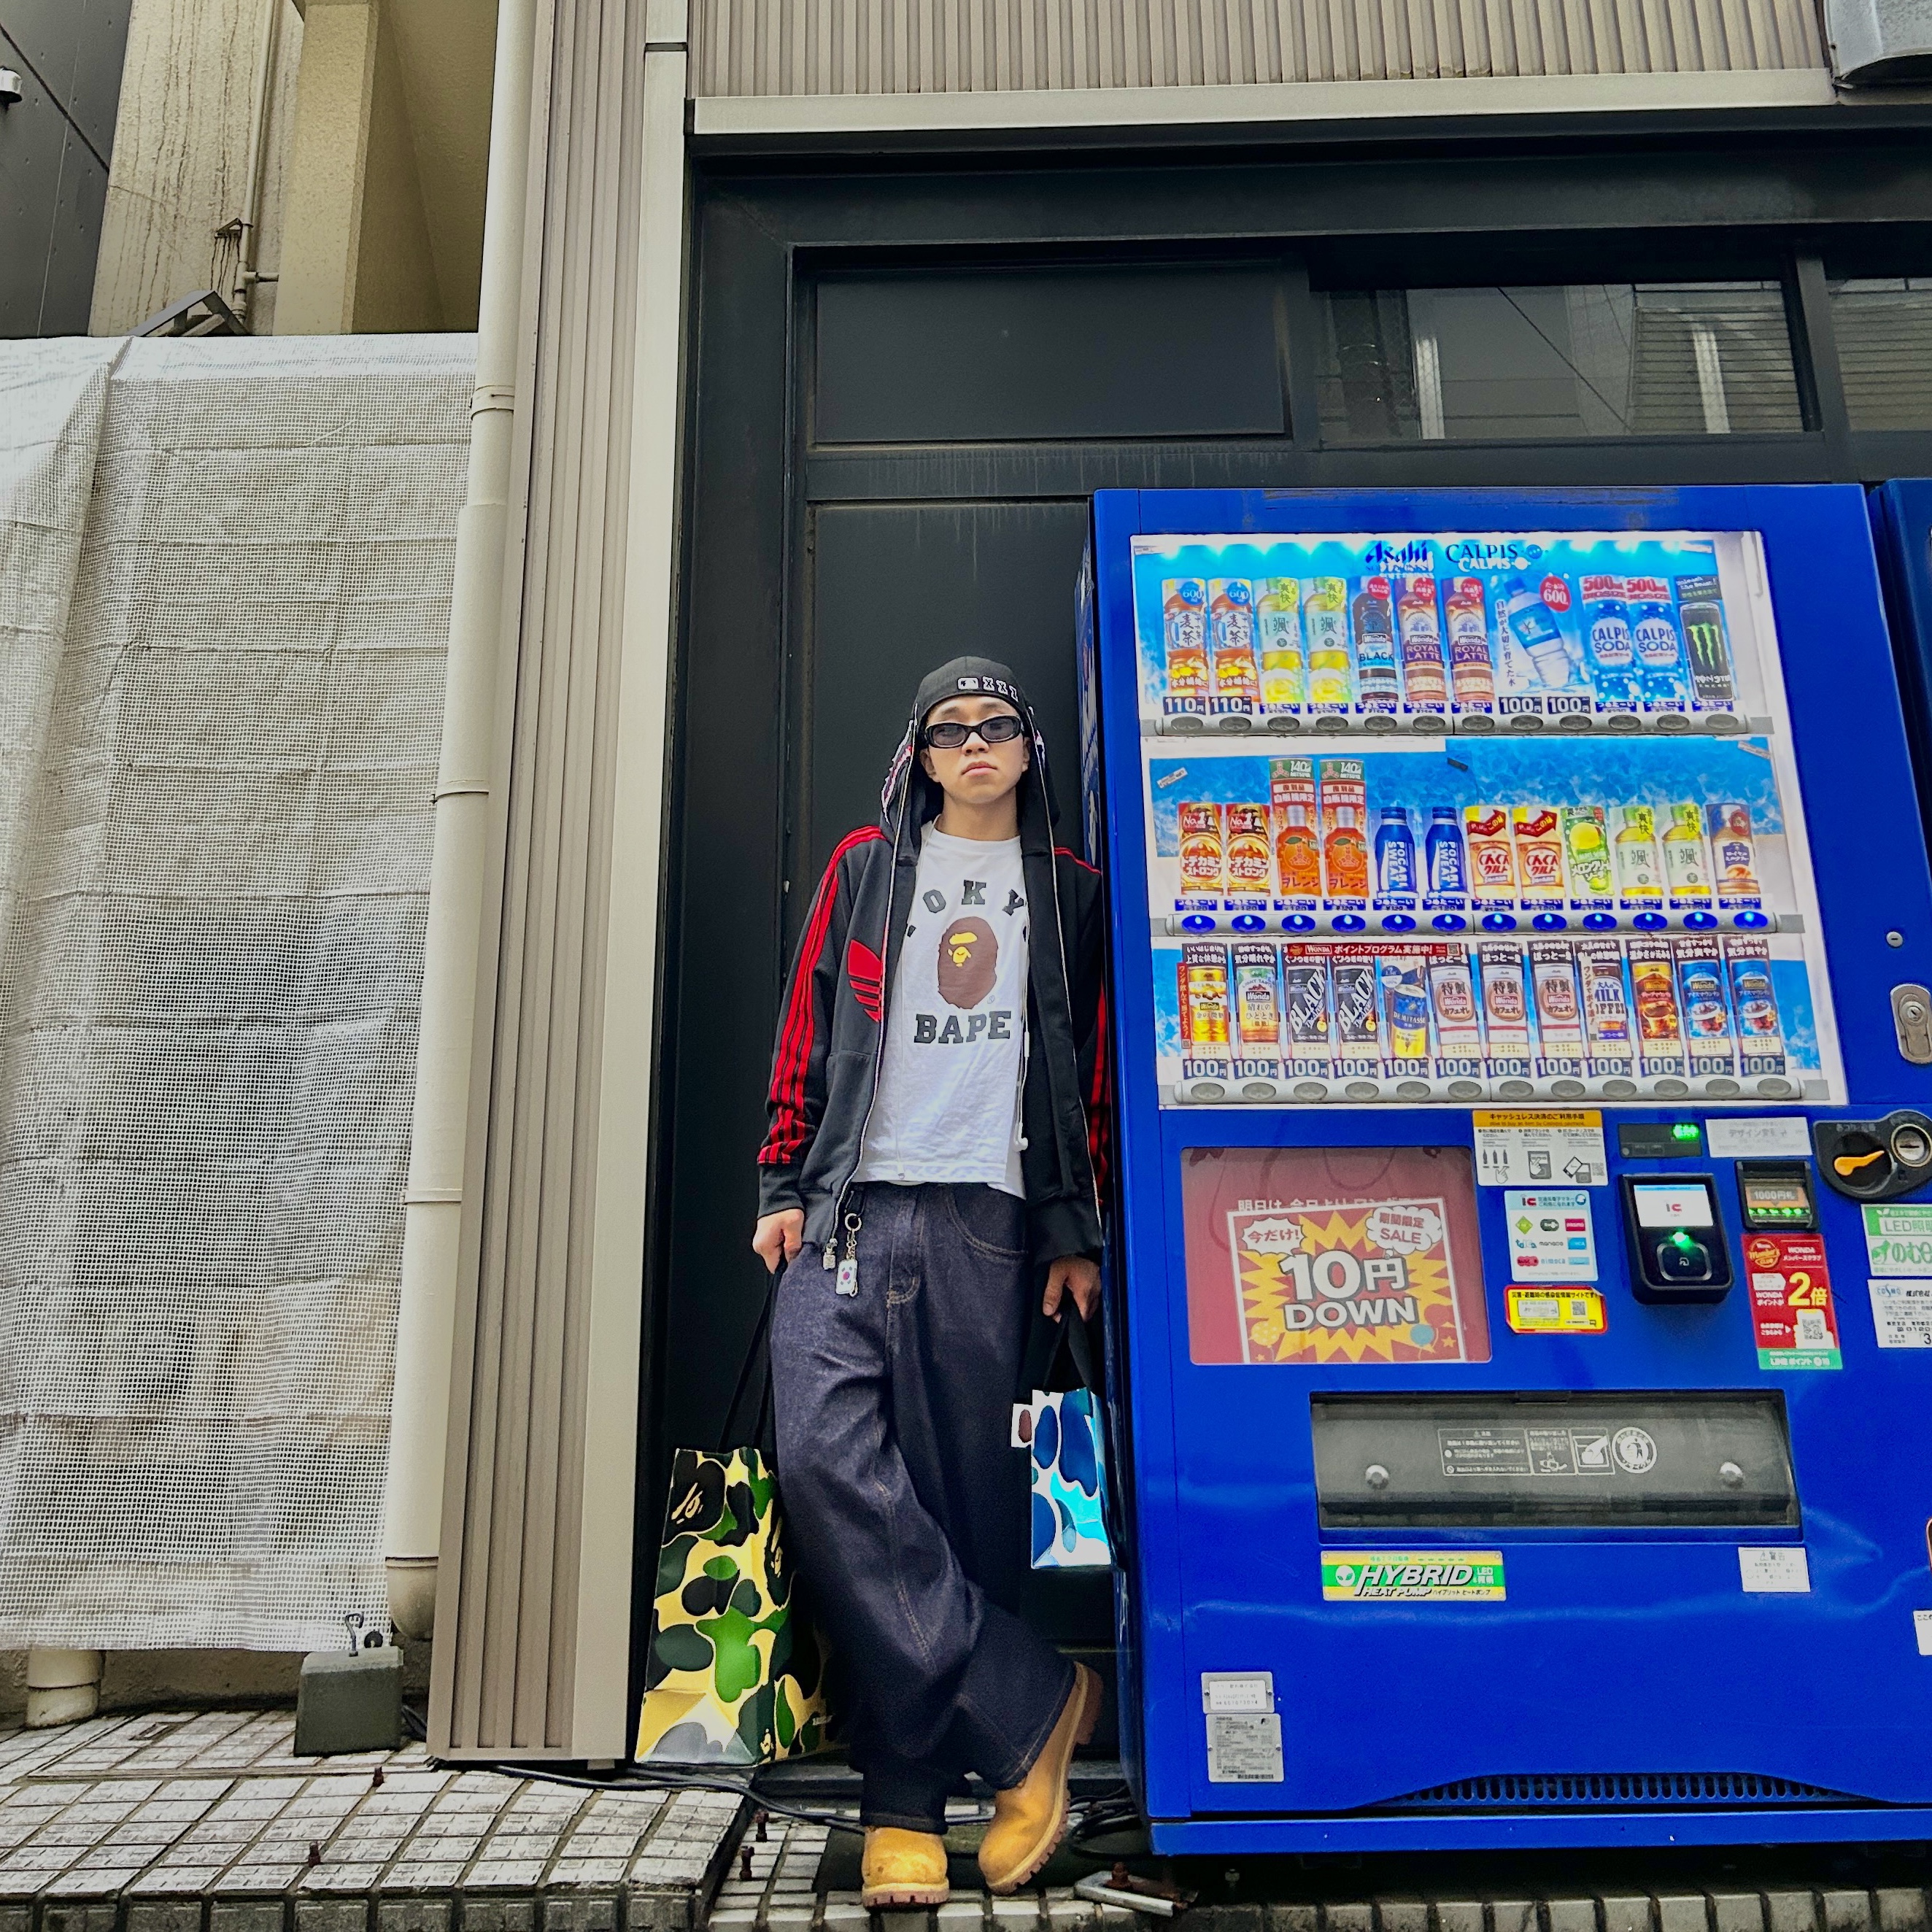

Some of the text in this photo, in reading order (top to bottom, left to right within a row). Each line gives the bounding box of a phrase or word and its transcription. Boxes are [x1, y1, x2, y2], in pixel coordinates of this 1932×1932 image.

[1365, 540, 1428, 563] Asahi
[1445, 544, 1518, 563] CALPIS
[1182, 589, 1203, 598] 600
[1543, 588, 1568, 604] 600
[1179, 614, 1197, 646] 麦茶
[1226, 614, 1244, 646] 麦茶
[1593, 627, 1629, 642] CALPIS
[1636, 627, 1674, 641] CALPIS
[1406, 645, 1440, 654] ROYAL
[1454, 645, 1488, 654] ROYAL
[1594, 641, 1631, 653] SODA
[1638, 641, 1677, 653] SODA
[1359, 652, 1394, 662] BLACK
[1407, 652, 1441, 660] LATTE
[1455, 653, 1488, 661] LATTE
[1388, 841, 1400, 882] SWEAT
[1439, 841, 1451, 882] SWEAT
[906, 879, 1027, 942] OKY
[1307, 946, 1331, 954] WONDA
[1246, 991, 1270, 1001] Wonda
[1290, 969, 1326, 1035] BLACK
[1338, 969, 1375, 1035] BLACK
[913, 1011, 1012, 1044] BAPE
[1379, 1213, 1425, 1229] 期間限定
[1248, 1229, 1299, 1244] 今だけ!
[1379, 1228, 1422, 1245] SALE
[1788, 1246, 1815, 1254] WONDA
[1280, 1249, 1409, 1302] 10円
[1788, 1272, 1828, 1307] 2倍
[1283, 1297, 1418, 1332] DOWN
[1354, 1565, 1474, 1596] HYBRID
[1364, 1588, 1397, 1596] HEAT
